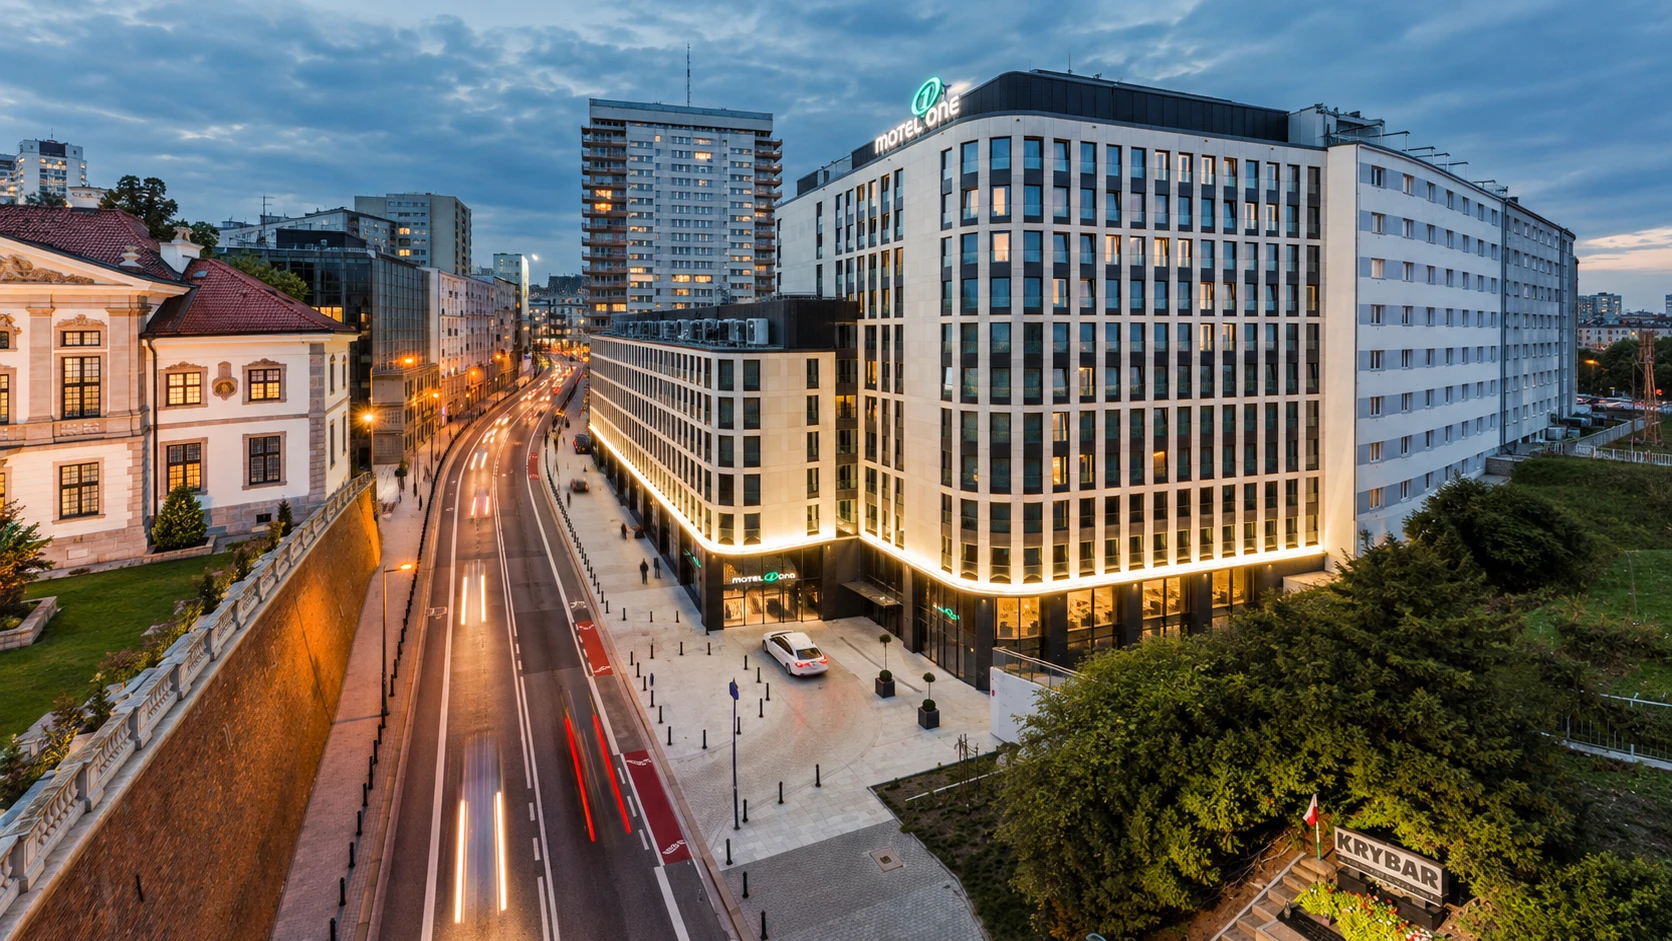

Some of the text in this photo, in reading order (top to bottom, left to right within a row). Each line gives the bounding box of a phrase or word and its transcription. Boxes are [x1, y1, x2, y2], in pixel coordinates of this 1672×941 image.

[874, 117, 923, 154] MOTEL
[732, 575, 763, 584] MOTEL
[1337, 831, 1439, 891] KRYBAR
